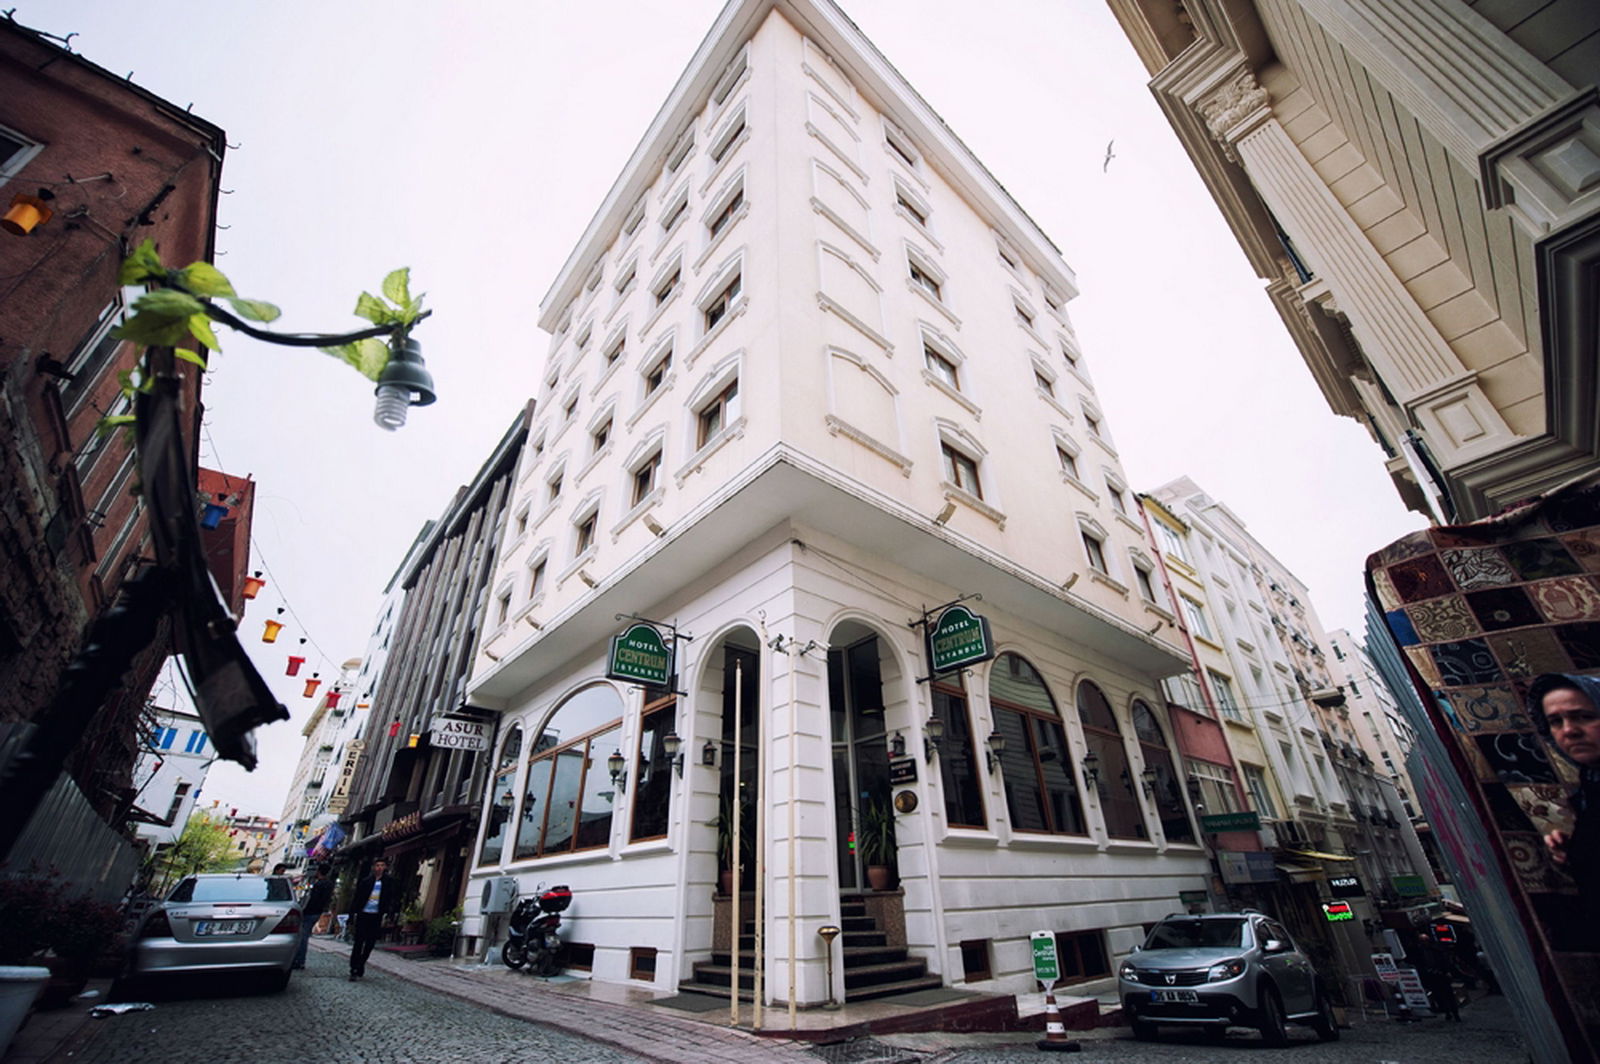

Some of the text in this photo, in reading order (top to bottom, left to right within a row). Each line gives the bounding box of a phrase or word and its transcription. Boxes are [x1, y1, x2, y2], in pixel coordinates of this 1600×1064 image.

[941, 620, 970, 635] HOTEL
[628, 639, 659, 653] HOTEL
[935, 627, 981, 654] CENTRUM
[617, 647, 666, 670] CENTRUM
[442, 721, 484, 737] ASUR
[437, 733, 484, 750] HOTEL
